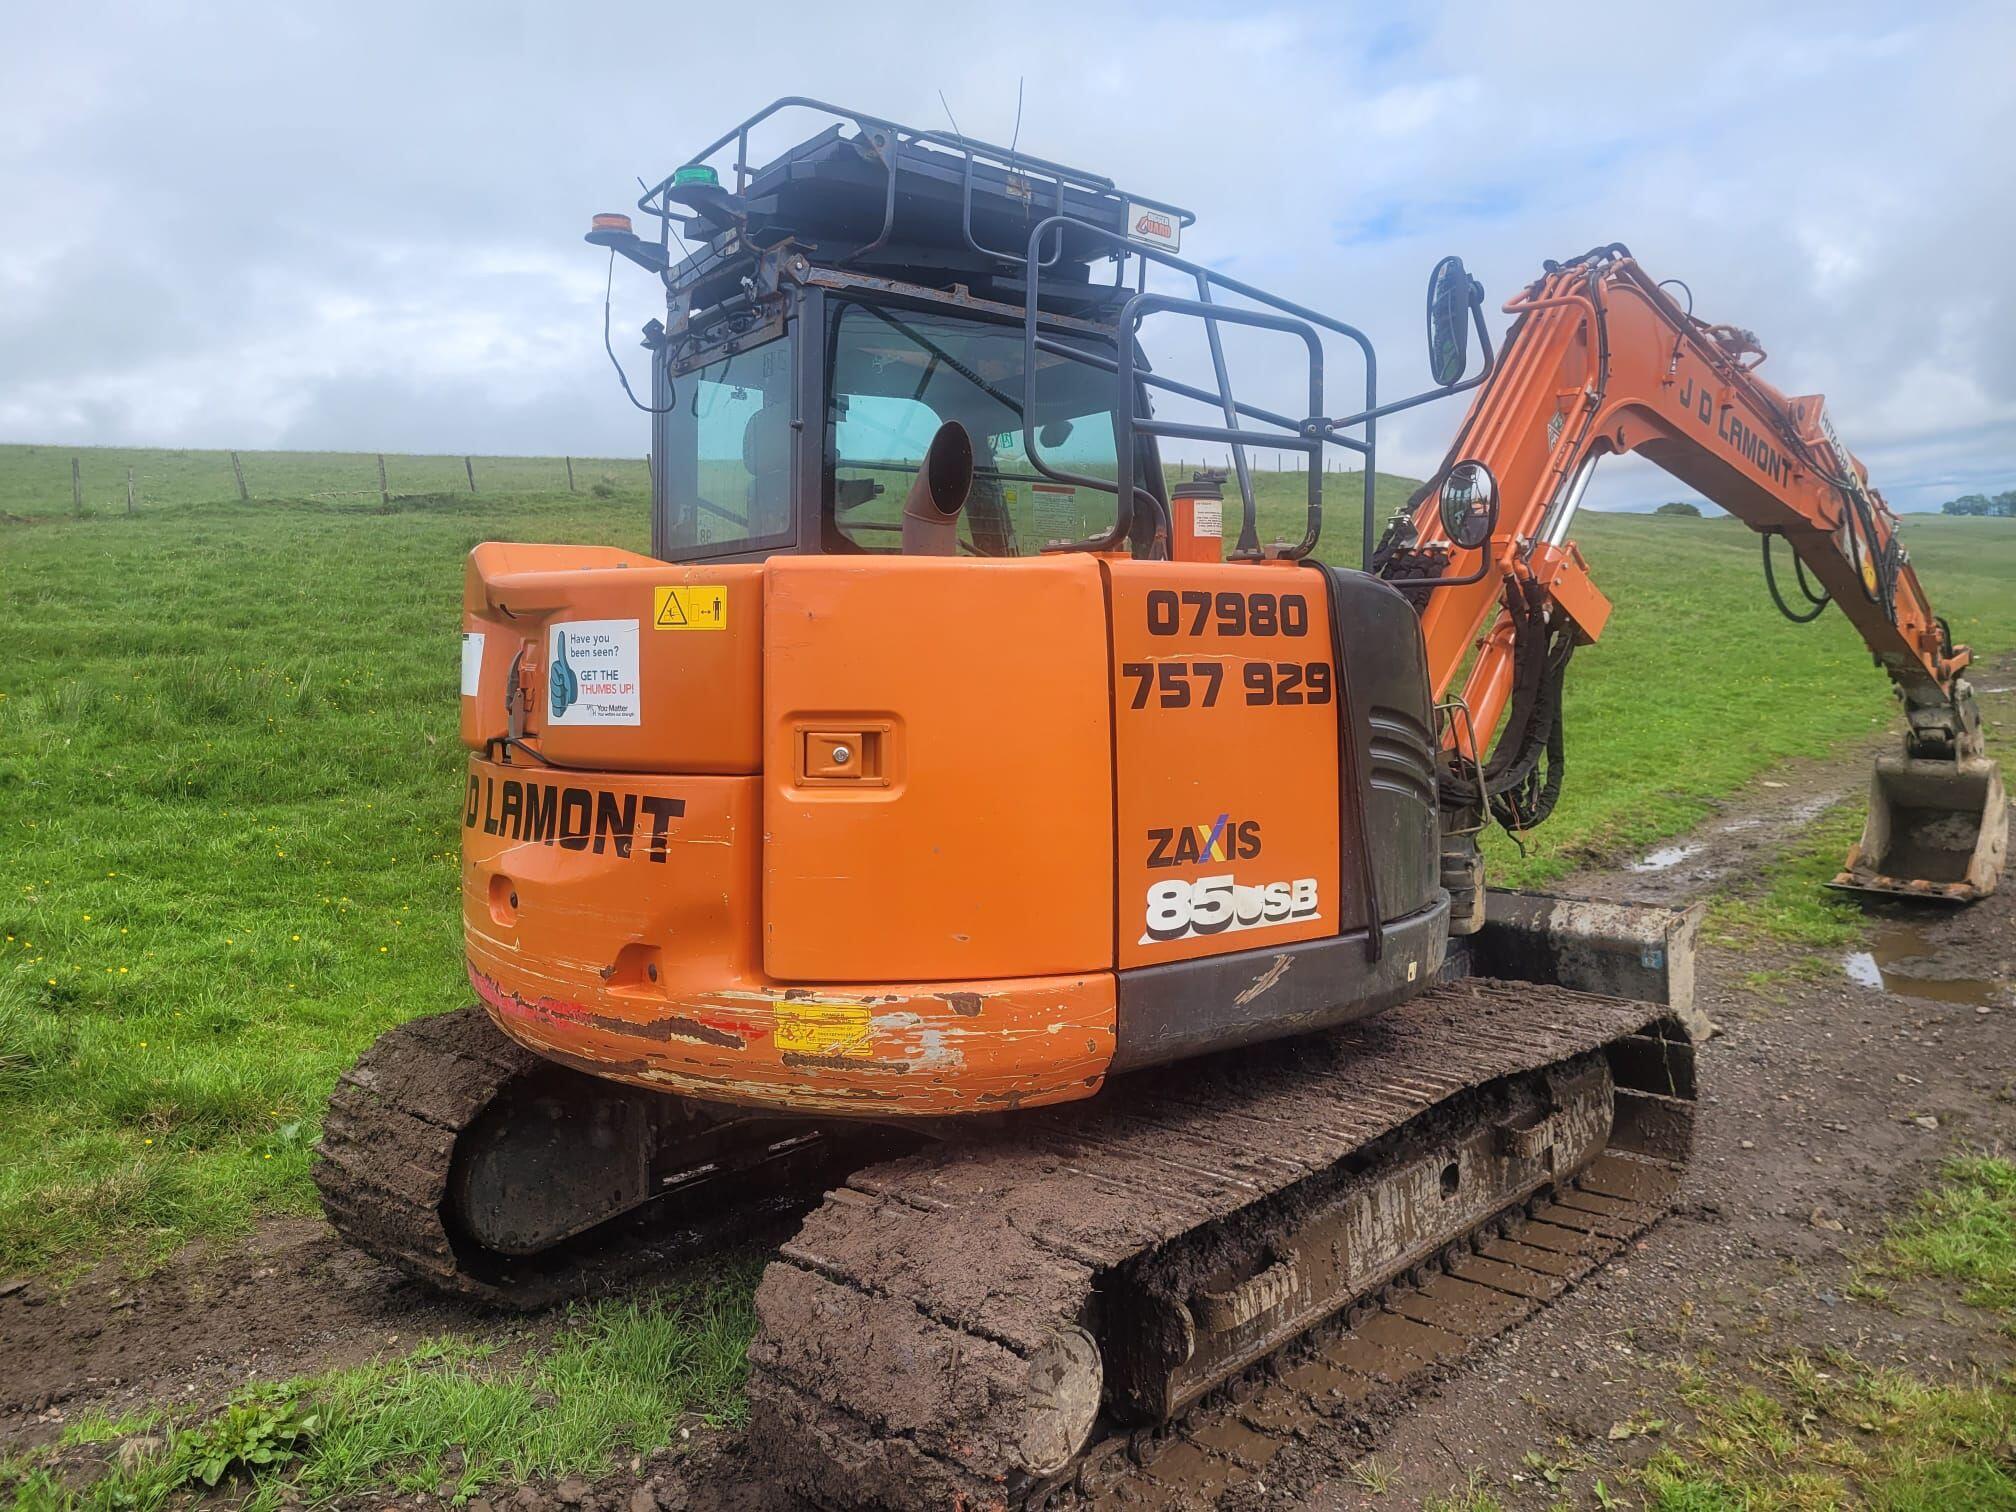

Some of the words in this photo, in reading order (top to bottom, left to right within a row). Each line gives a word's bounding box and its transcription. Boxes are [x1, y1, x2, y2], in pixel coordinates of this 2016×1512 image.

[1679, 377, 1693, 409] J
[1698, 388, 1713, 426] D
[1718, 404, 1793, 488] LAMONT
[1820, 411, 1849, 472] HITACHI
[1146, 590, 1308, 637] 07980
[570, 633, 591, 645] Have
[593, 634, 610, 647] you
[570, 647, 590, 658] been
[593, 645, 619, 658] seen?
[580, 670, 597, 681] GET
[600, 669, 619, 681] THE
[580, 683, 617, 695] THUMBS
[619, 683, 635, 695] UP!
[1122, 662, 1225, 710] 757
[1243, 662, 1332, 707] 929
[597, 704, 608, 712] You
[609, 704, 628, 712] Matter
[465, 774, 480, 829] D
[484, 776, 686, 864] LAMONT
[1146, 813, 1262, 869] ZAXIS
